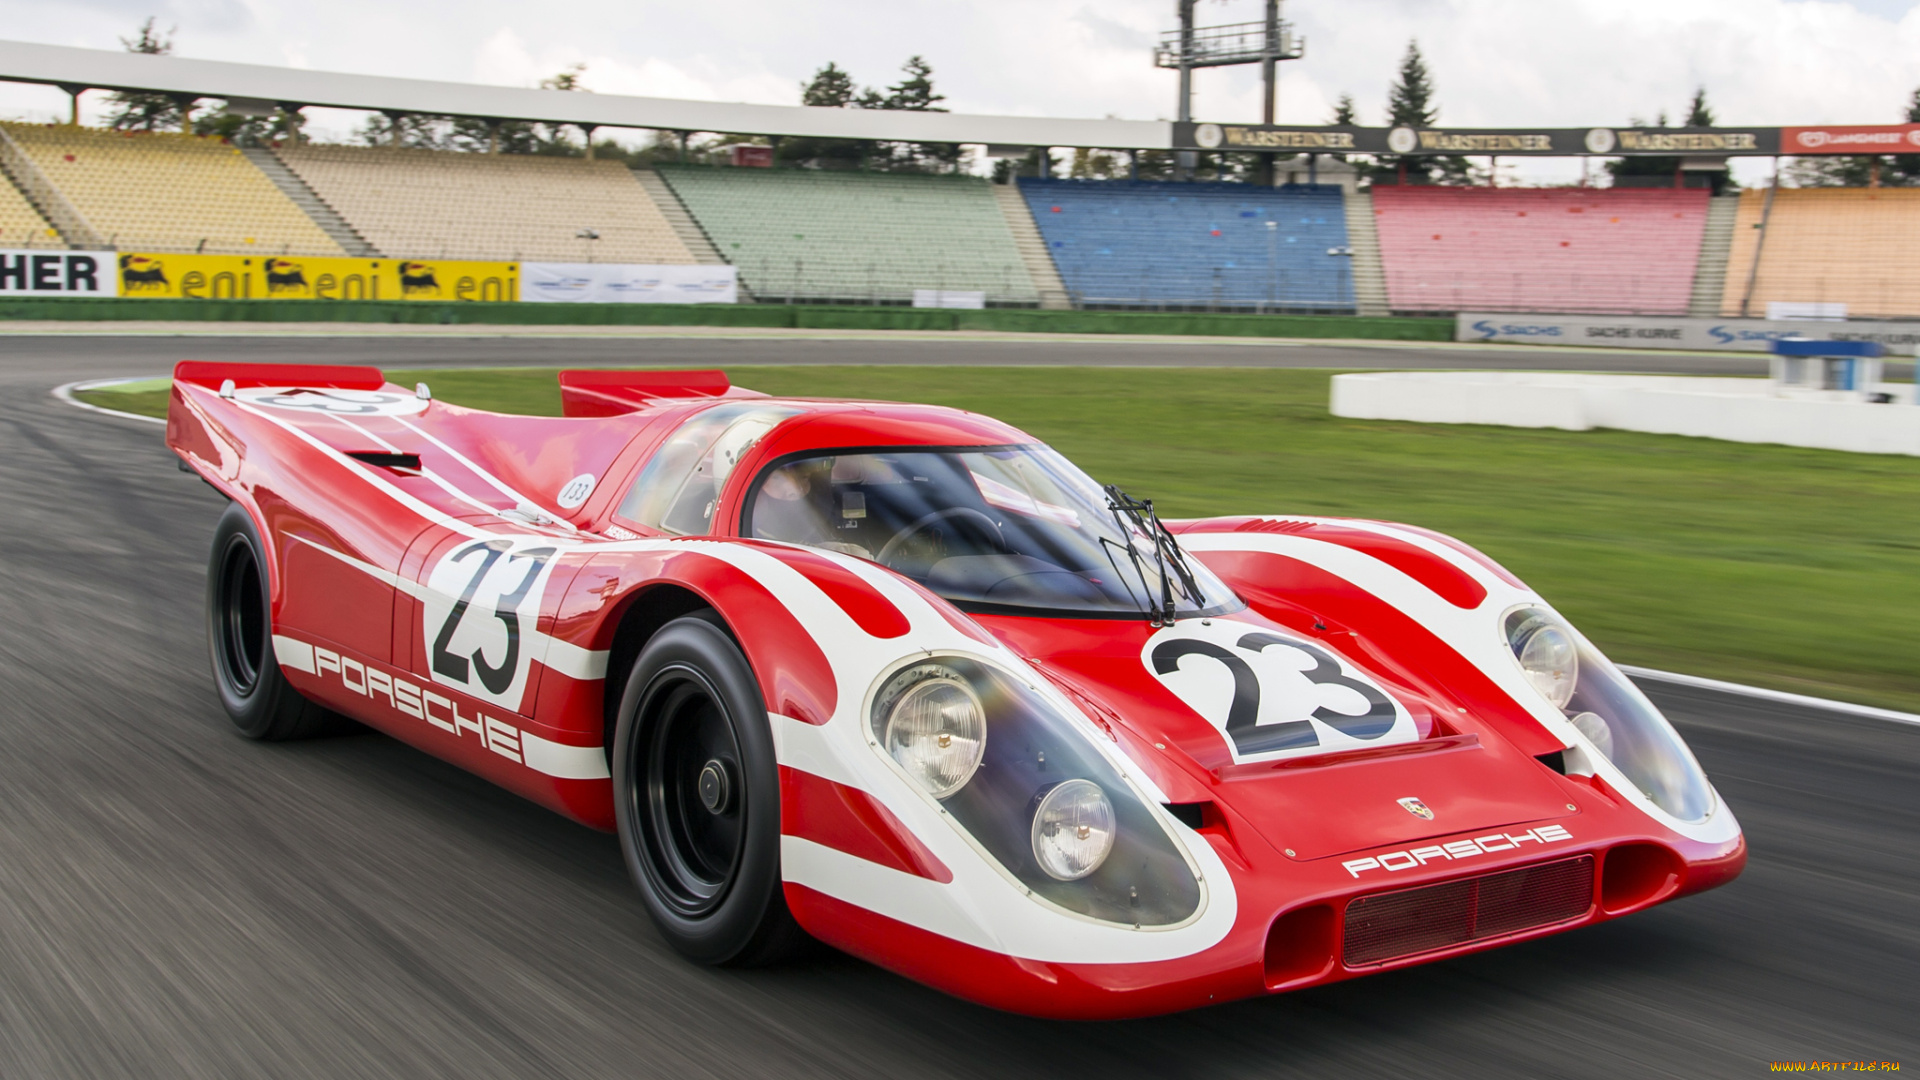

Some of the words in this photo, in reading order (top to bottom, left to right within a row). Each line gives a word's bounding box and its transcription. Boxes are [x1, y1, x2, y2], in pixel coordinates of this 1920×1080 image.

[0, 254, 99, 291] HER
[180, 258, 253, 299] eni
[315, 261, 379, 300] eni
[456, 264, 516, 301] eni
[1501, 325, 1563, 337] SACHS
[562, 481, 590, 501] 133
[433, 539, 558, 695] 23
[314, 645, 523, 764] PORSCHE
[1151, 632, 1397, 756] 23
[1341, 824, 1574, 879] PORSCHE
